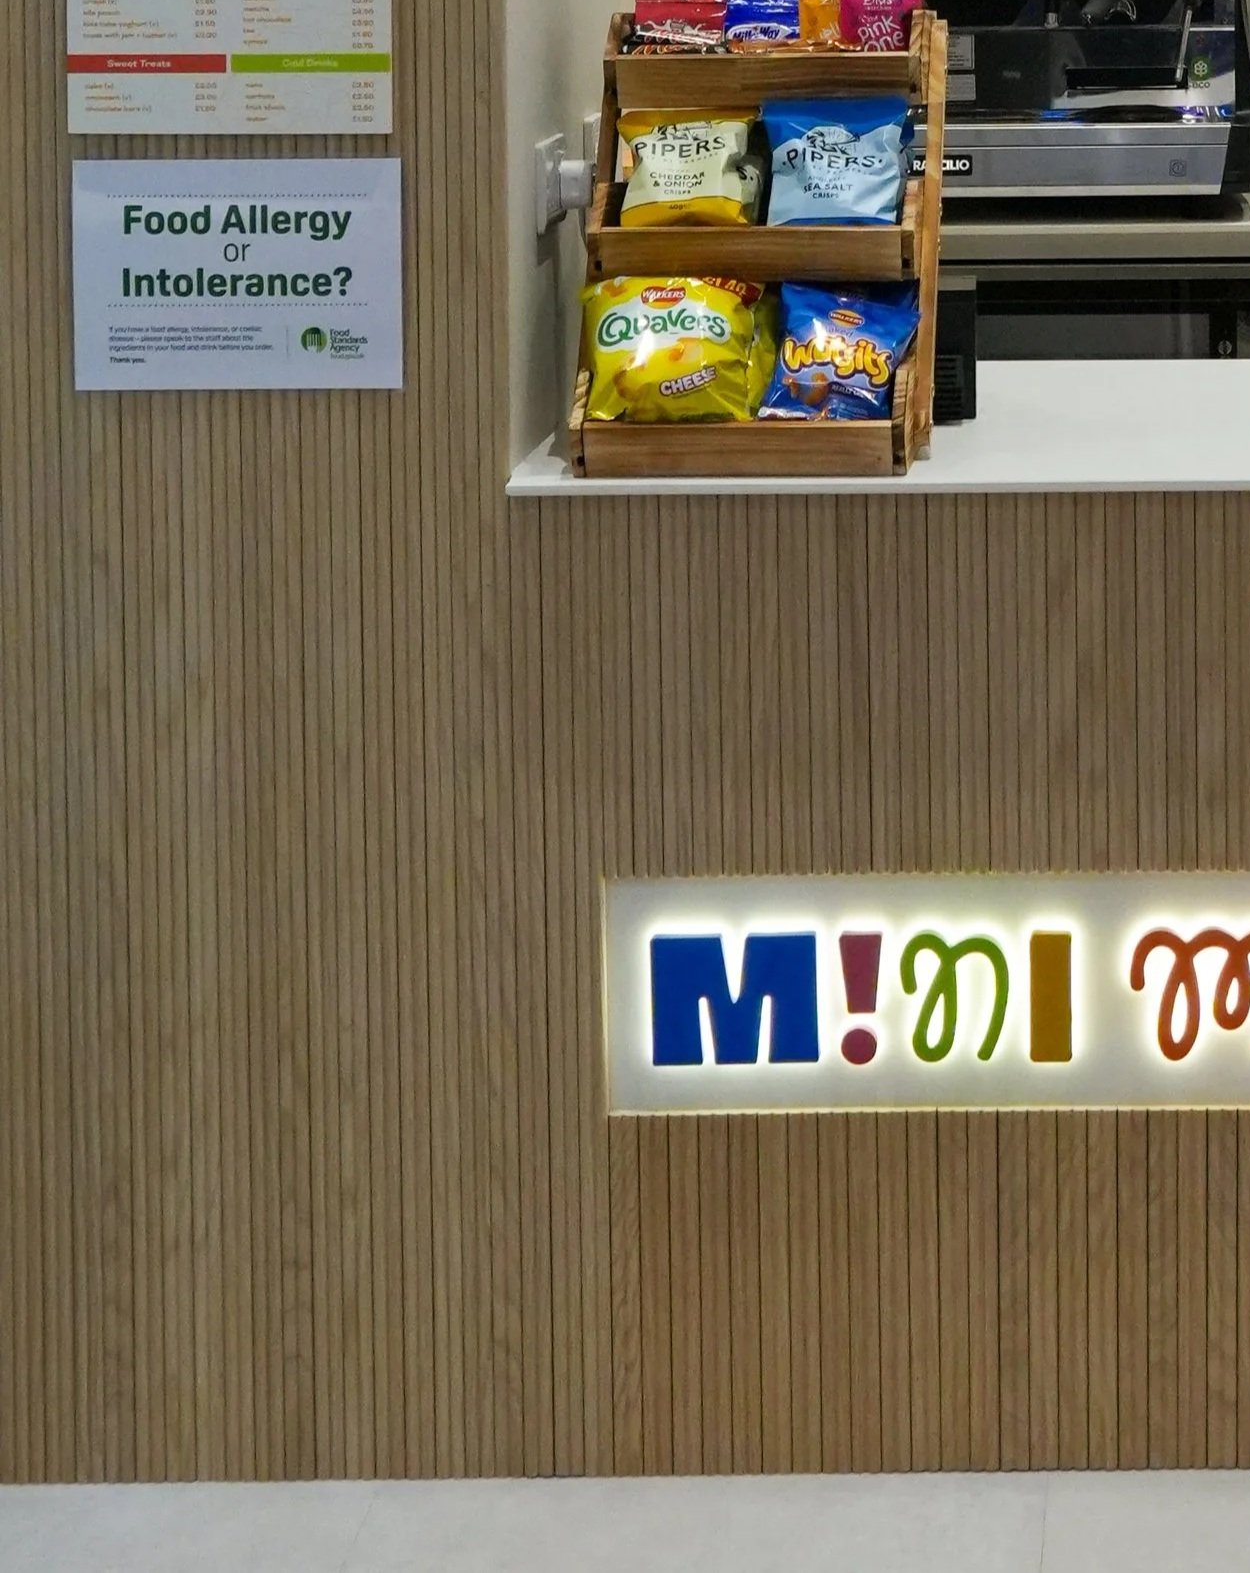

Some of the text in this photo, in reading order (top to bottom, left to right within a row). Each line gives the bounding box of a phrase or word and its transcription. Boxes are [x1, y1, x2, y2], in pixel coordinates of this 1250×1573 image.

[106, 59, 172, 69] Sweet Treats
[634, 136, 726, 158] PIPERS
[649, 171, 705, 180] CHEDDAR
[664, 180, 703, 188] ONION
[803, 182, 854, 194] SEA SALT
[123, 204, 352, 241] Food Allergy
[223, 242, 251, 263] or
[122, 266, 353, 297] Intolerance?
[330, 328, 351, 337] Food
[329, 335, 369, 344] Standards
[329, 344, 361, 354] Agency
[660, 367, 716, 396] CHEESE
